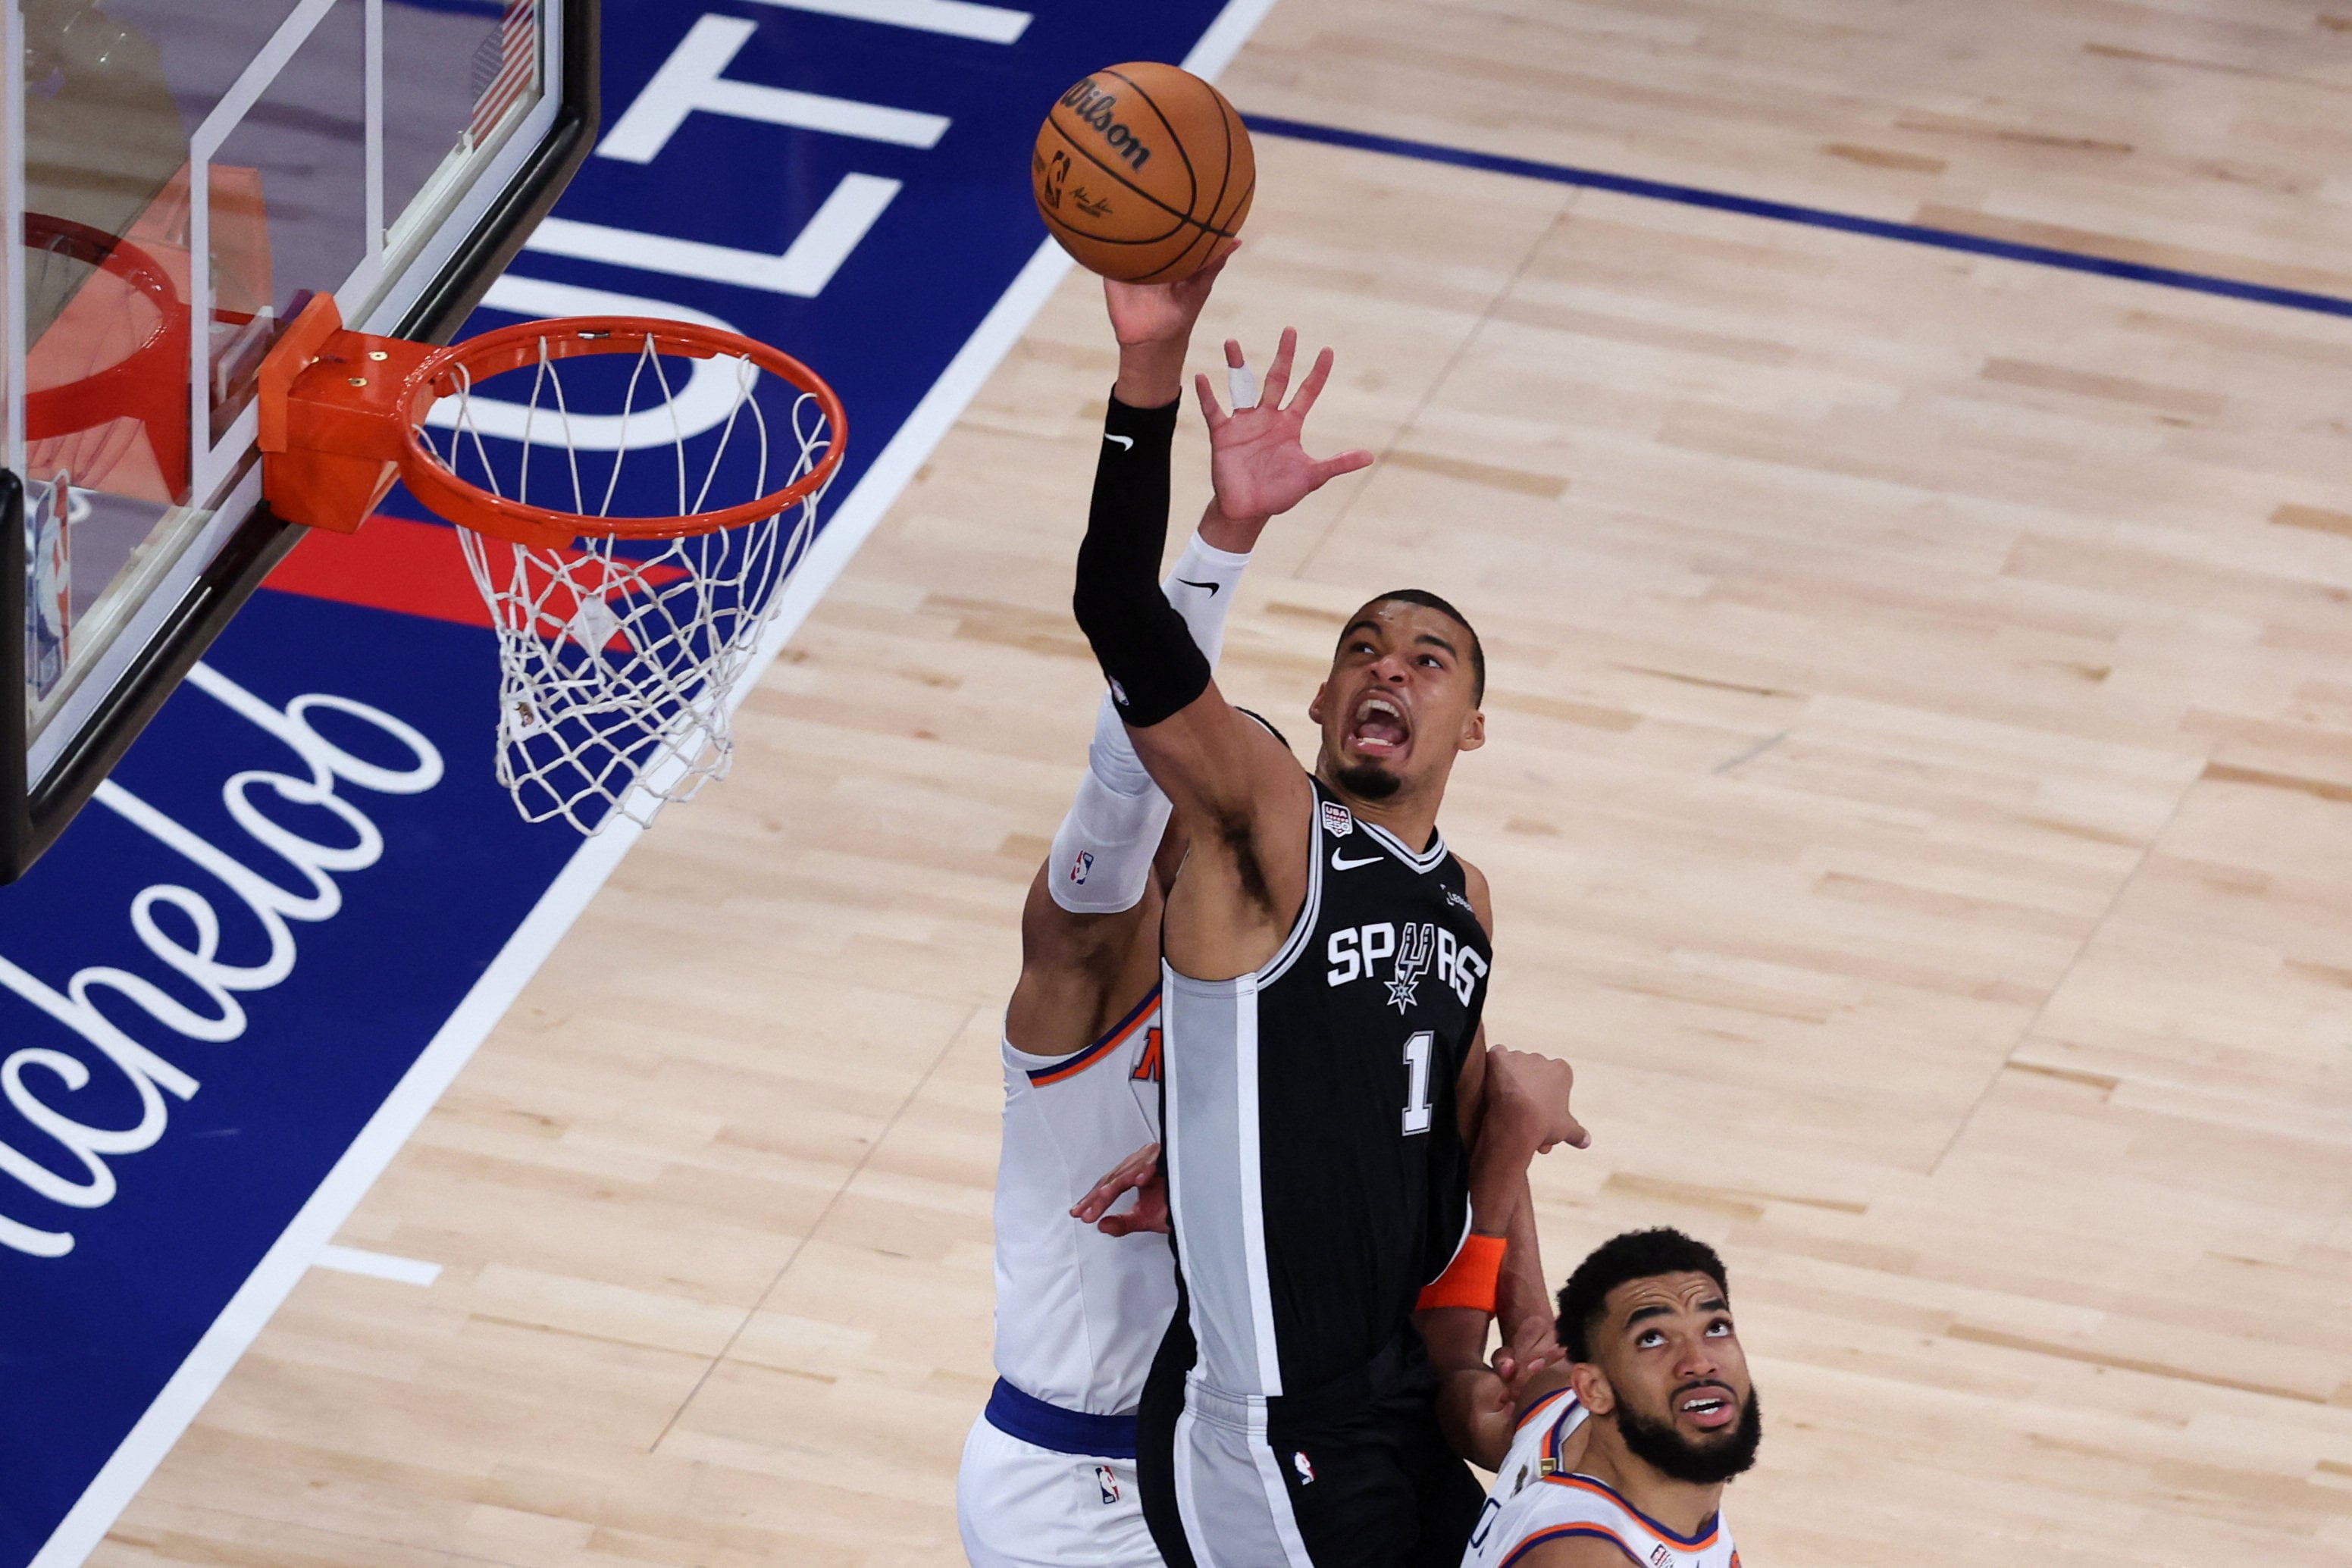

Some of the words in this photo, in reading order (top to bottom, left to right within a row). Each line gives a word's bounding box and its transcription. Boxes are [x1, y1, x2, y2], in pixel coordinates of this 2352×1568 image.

[1060, 77, 1152, 172] Wilson
[426, 0, 1034, 451] ULT
[1326, 806, 1348, 818] USA
[1326, 818, 1350, 831] 250
[1326, 922, 1489, 1016] SPURS
[1401, 1030, 1435, 1137] 1
